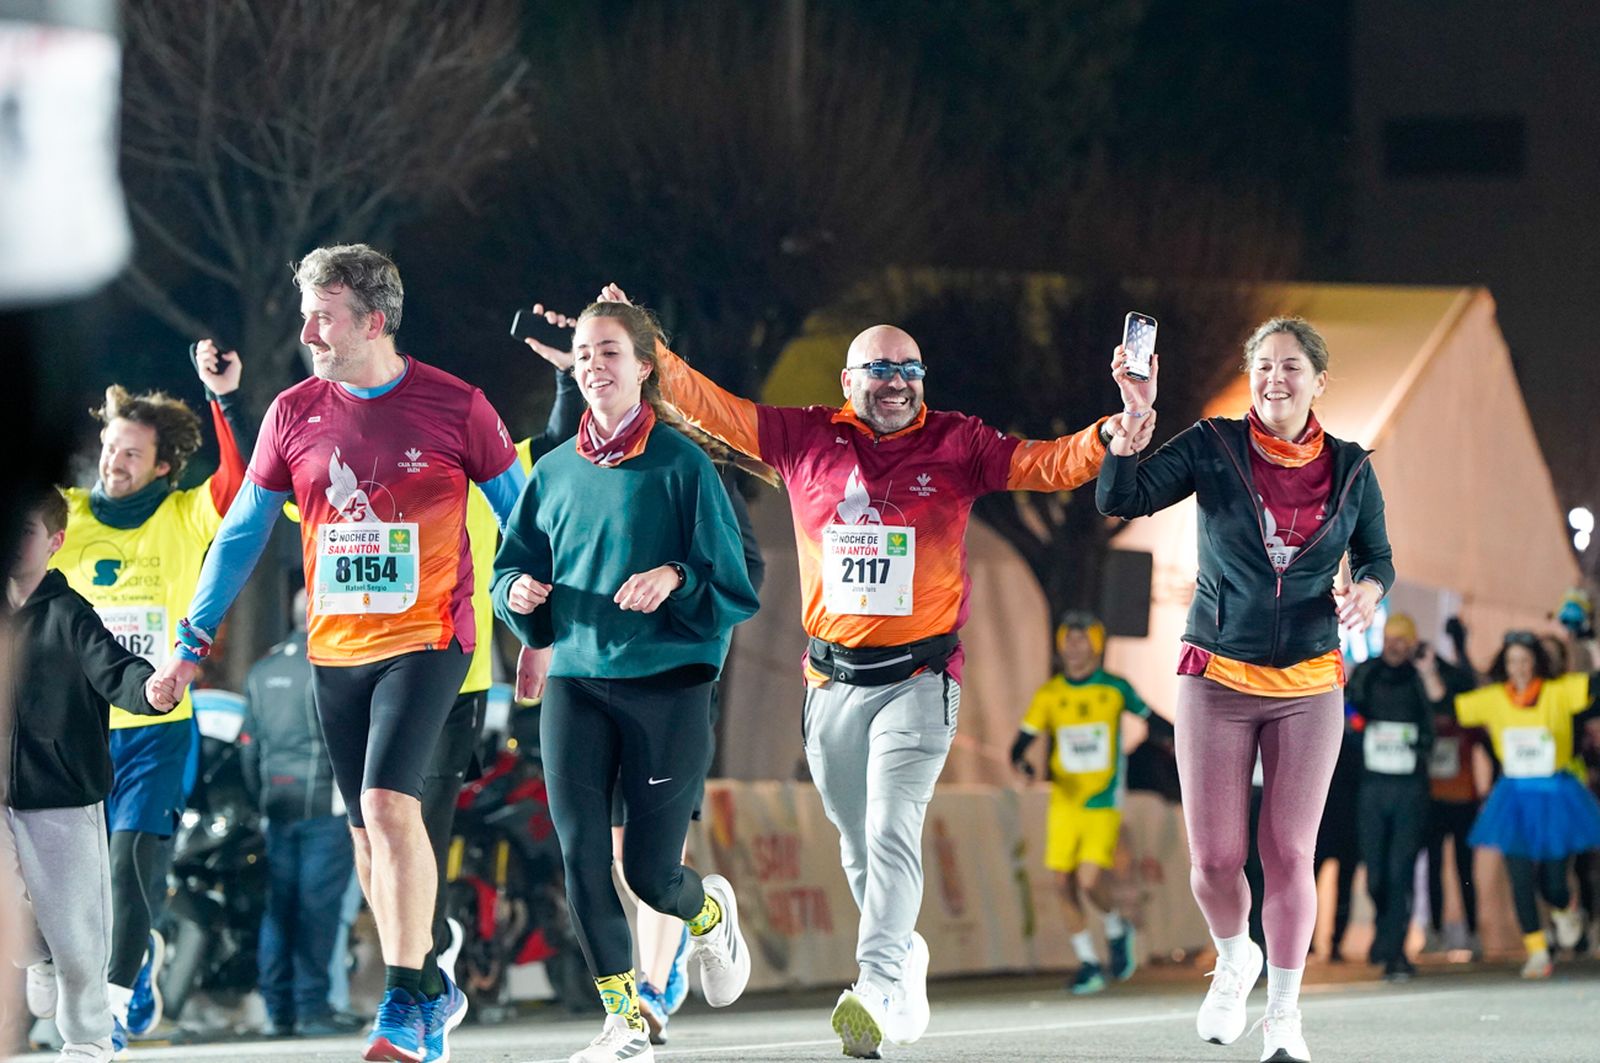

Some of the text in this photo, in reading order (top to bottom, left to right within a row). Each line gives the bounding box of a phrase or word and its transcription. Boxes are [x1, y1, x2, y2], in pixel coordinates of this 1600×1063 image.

[343, 497, 367, 522] 43
[339, 533, 380, 542] NOCHE DE
[839, 535, 878, 545] NOCHE DE
[328, 545, 346, 554] SAN
[347, 543, 380, 554] ANTÓN
[848, 544, 878, 556] ANTÓN
[335, 555, 398, 583] 8154
[842, 558, 891, 584] 2117
[367, 584, 387, 592] Sergio
